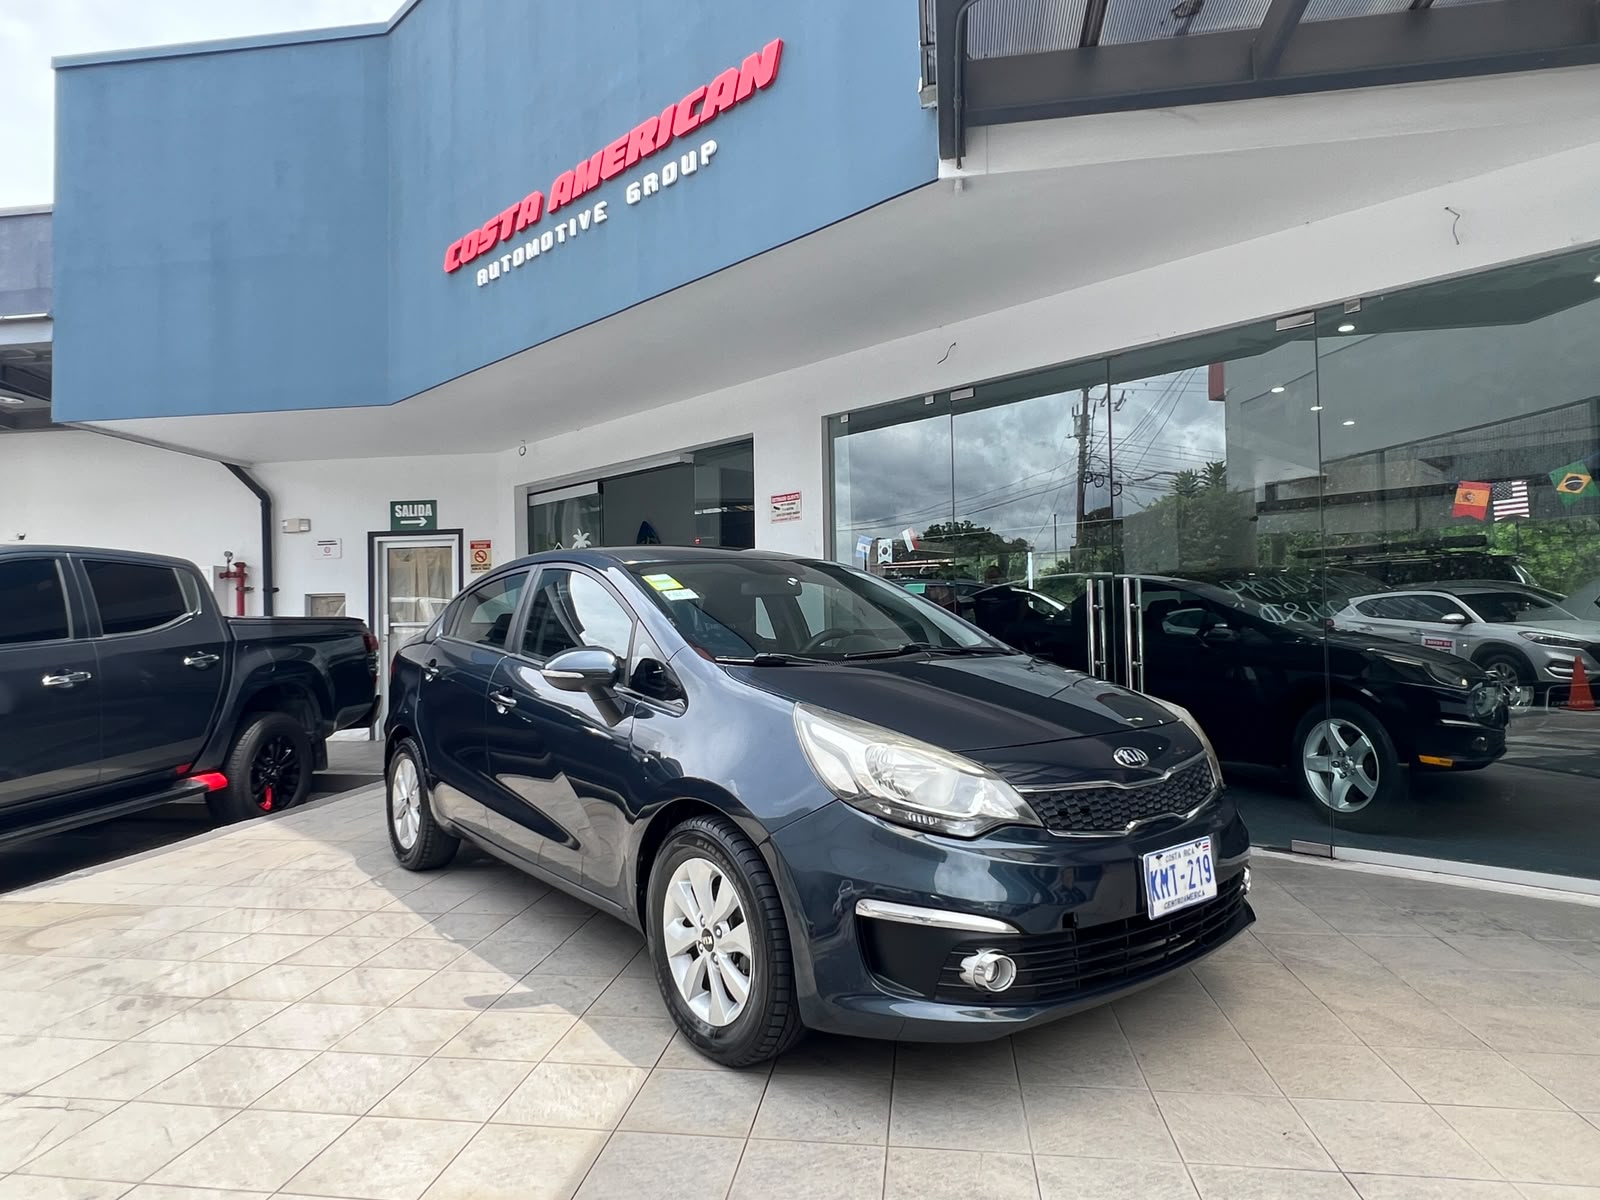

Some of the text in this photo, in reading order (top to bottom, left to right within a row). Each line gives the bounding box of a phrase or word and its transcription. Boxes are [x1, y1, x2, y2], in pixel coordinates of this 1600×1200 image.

[443, 38, 784, 274] COSTA AMERICAN
[476, 139, 718, 287] AUTOMOTIVE GROUP
[394, 503, 433, 518] SALIDA
[1117, 748, 1147, 764] KIA
[1165, 847, 1195, 863] COSTA RICA
[1150, 853, 1212, 902] KMT-219
[1163, 890, 1206, 910] CENTROAMERICA
